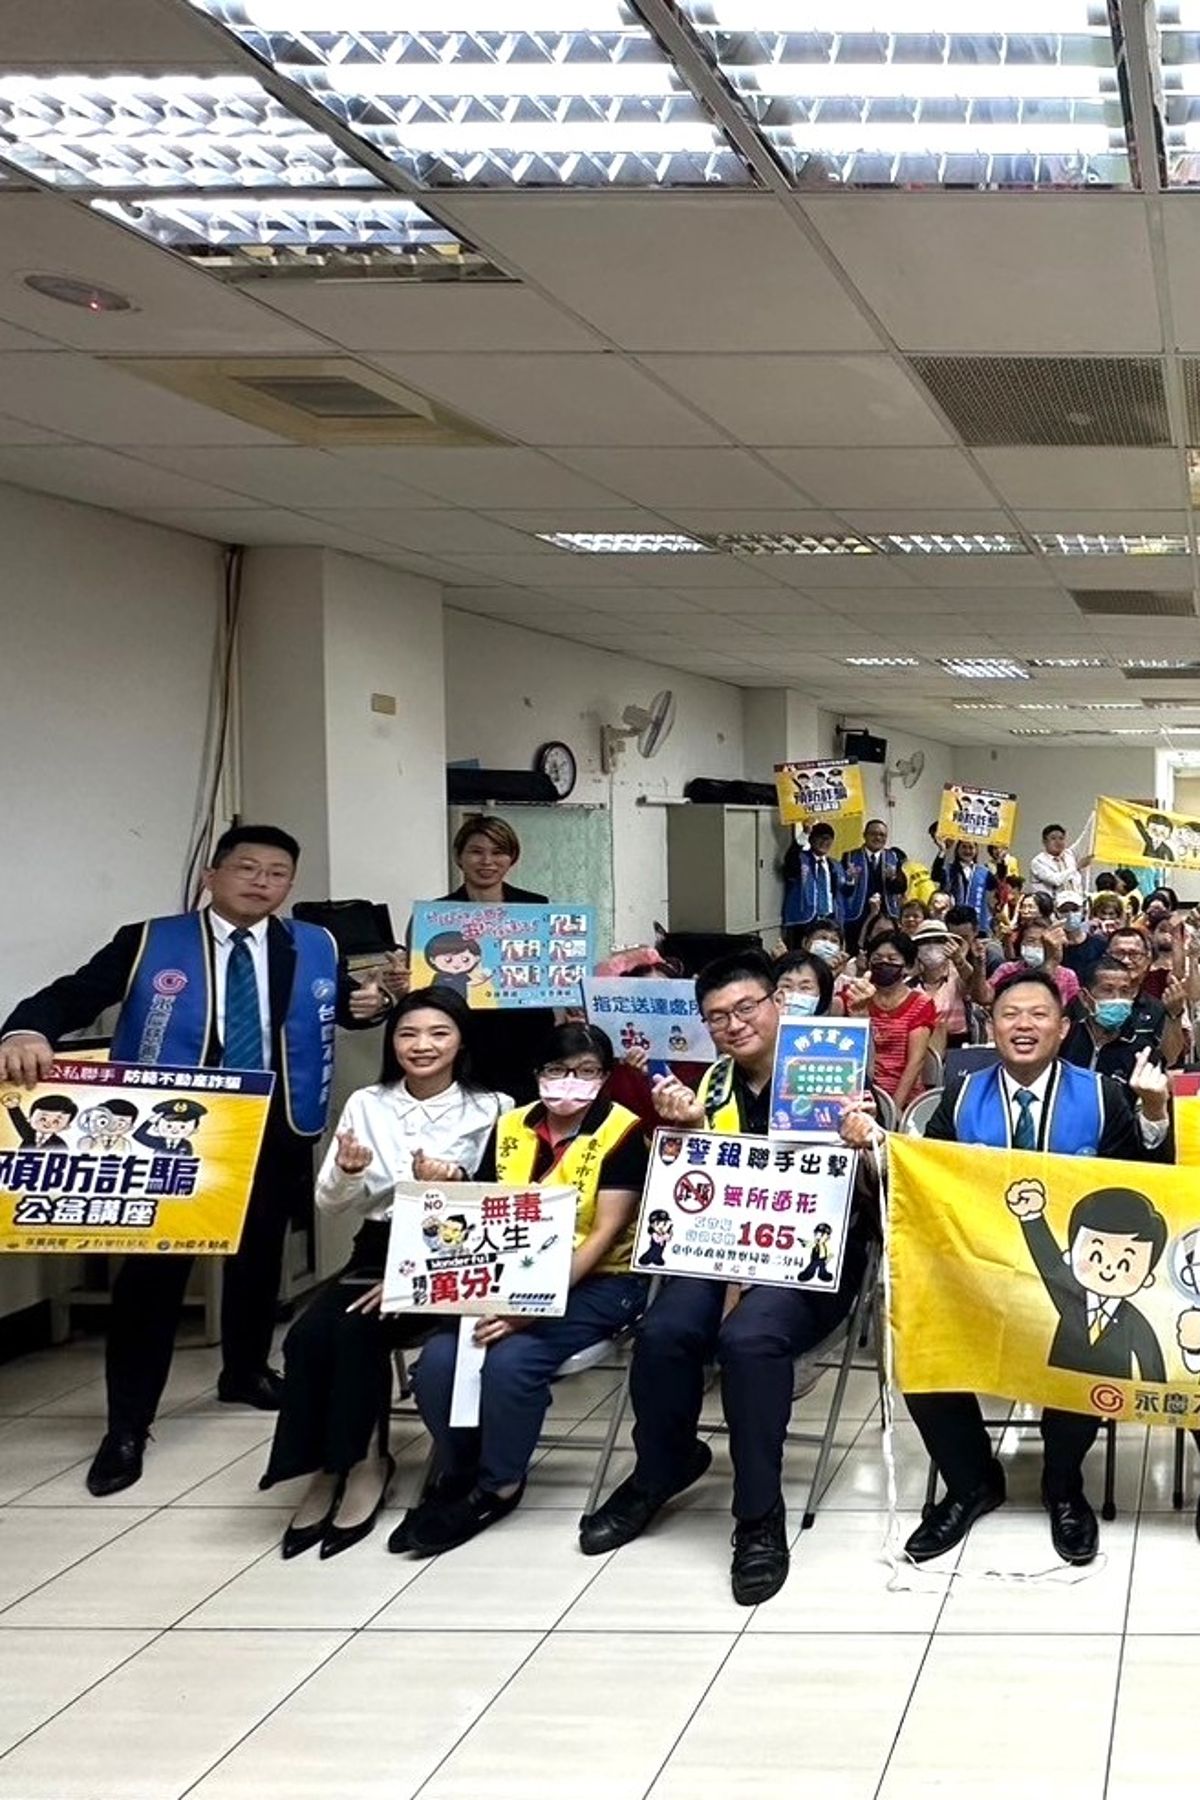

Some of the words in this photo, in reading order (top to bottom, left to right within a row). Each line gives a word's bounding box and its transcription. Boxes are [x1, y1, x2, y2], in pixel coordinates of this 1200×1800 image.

[686, 1137, 849, 1178] 警銀聯手出擊
[15, 1196, 156, 1227] 公益講座
[424, 1200, 444, 1212] NO
[481, 1192, 542, 1225] 無毒
[723, 1185, 818, 1214] 無所遁形
[473, 1224, 531, 1253] 人生
[737, 1222, 796, 1250] 165
[431, 1263, 504, 1304] 萬分!
